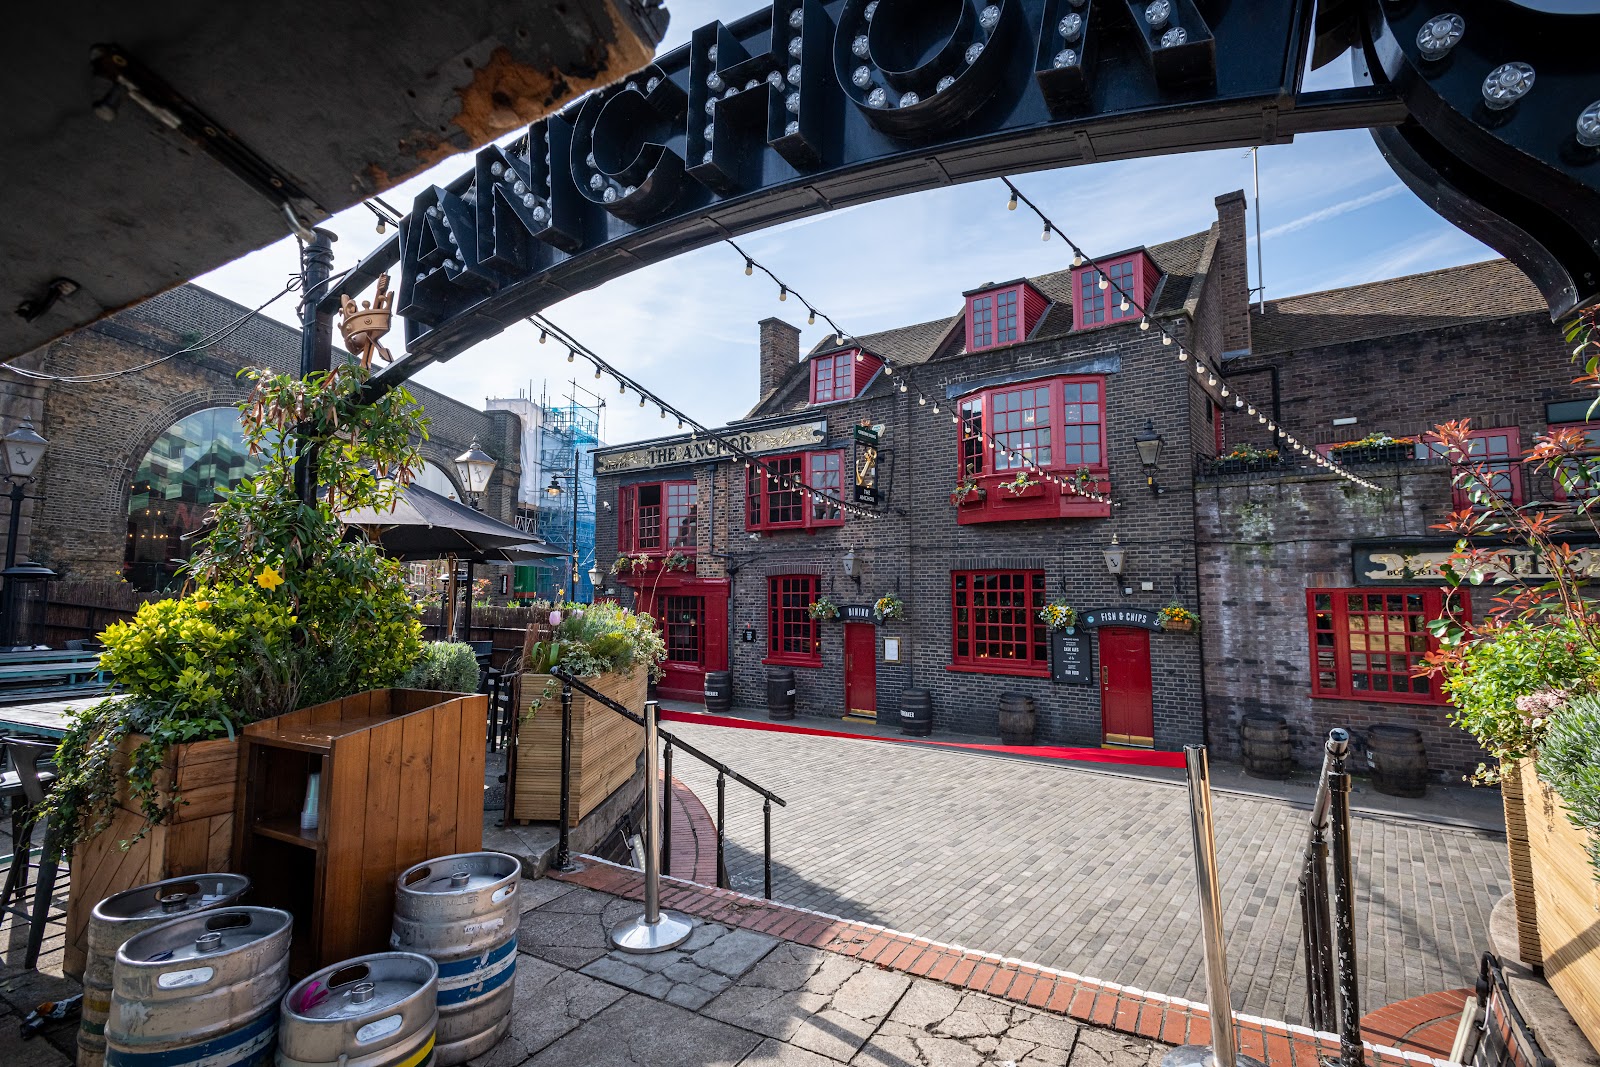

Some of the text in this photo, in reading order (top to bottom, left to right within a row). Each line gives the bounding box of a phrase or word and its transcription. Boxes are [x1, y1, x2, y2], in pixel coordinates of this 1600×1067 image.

[650, 435, 752, 465] THE ANCHOR
[859, 494, 875, 503] ANCHOR
[848, 607, 869, 618] DINING
[1100, 611, 1147, 624] FISH & CHIPS
